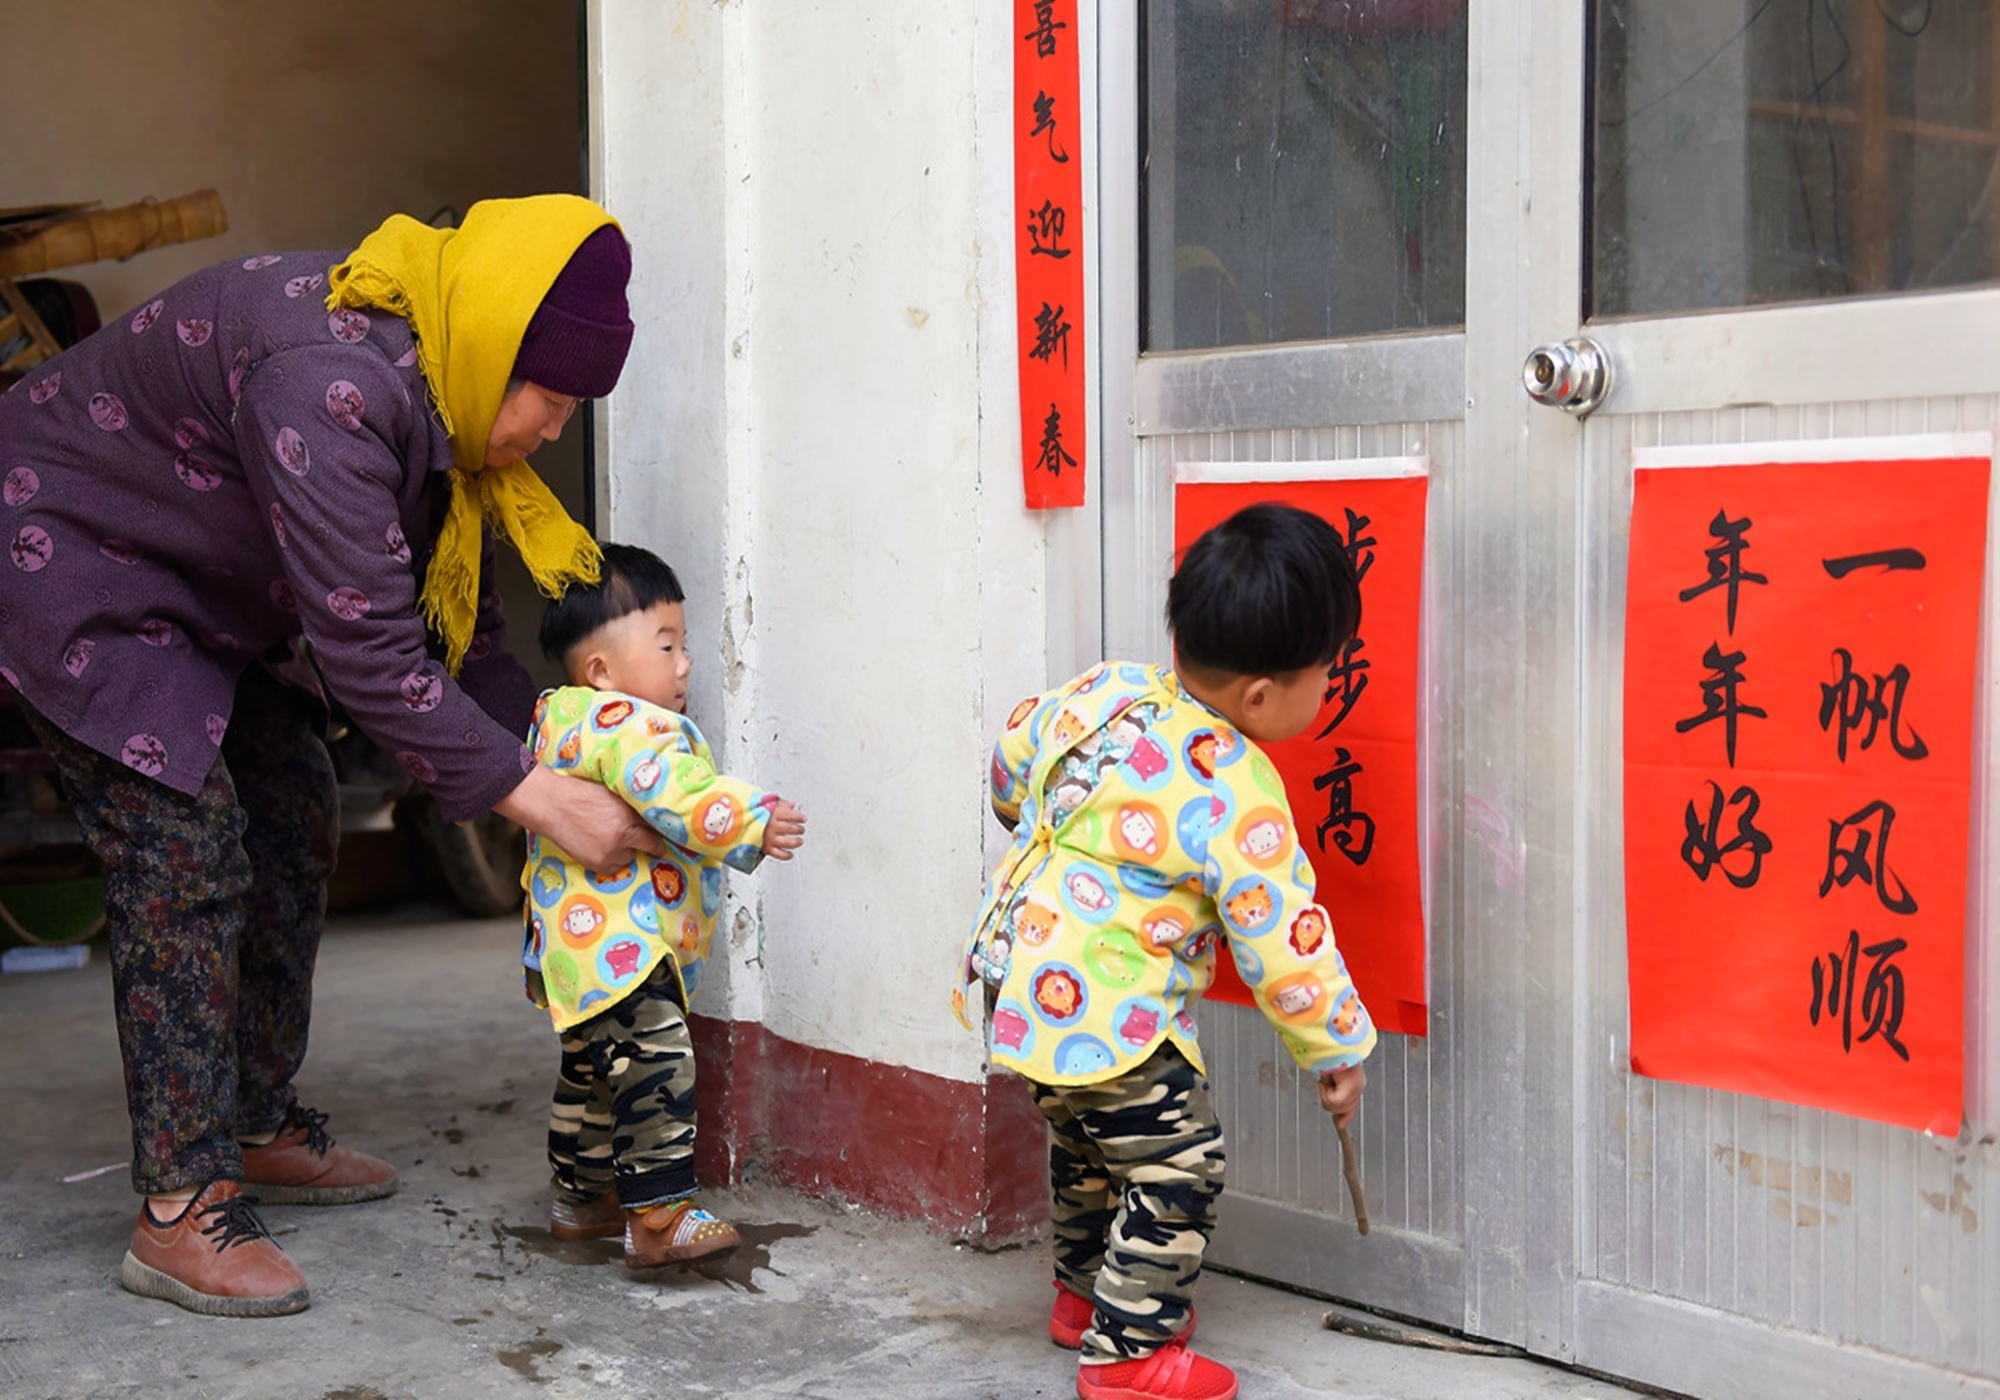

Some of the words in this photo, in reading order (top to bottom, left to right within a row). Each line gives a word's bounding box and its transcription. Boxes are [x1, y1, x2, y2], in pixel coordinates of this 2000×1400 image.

[1025, 0, 1077, 477] 喜气迎新春
[1675, 510, 1773, 890] 年年好
[1808, 547, 1930, 1062] 一帆风顺
